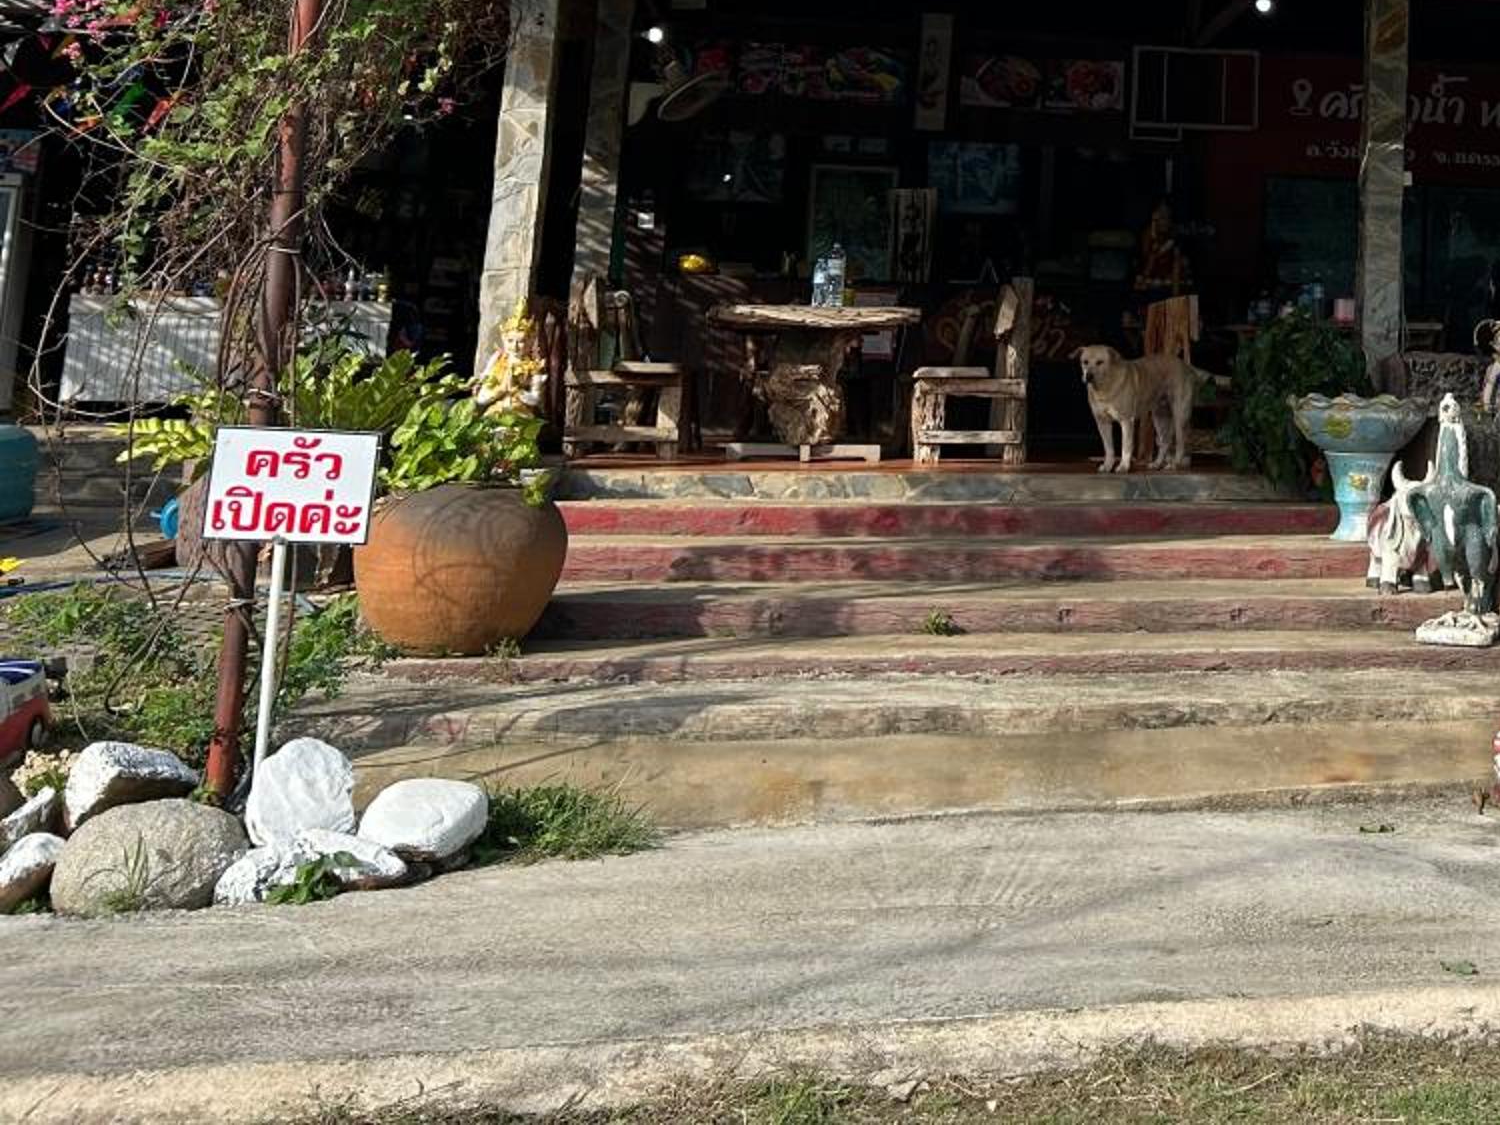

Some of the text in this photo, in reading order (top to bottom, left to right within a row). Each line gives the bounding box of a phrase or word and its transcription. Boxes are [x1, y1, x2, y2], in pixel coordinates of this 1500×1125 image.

[244, 435, 344, 481] ครัว
[211, 485, 363, 536] เปิดค่ะ
